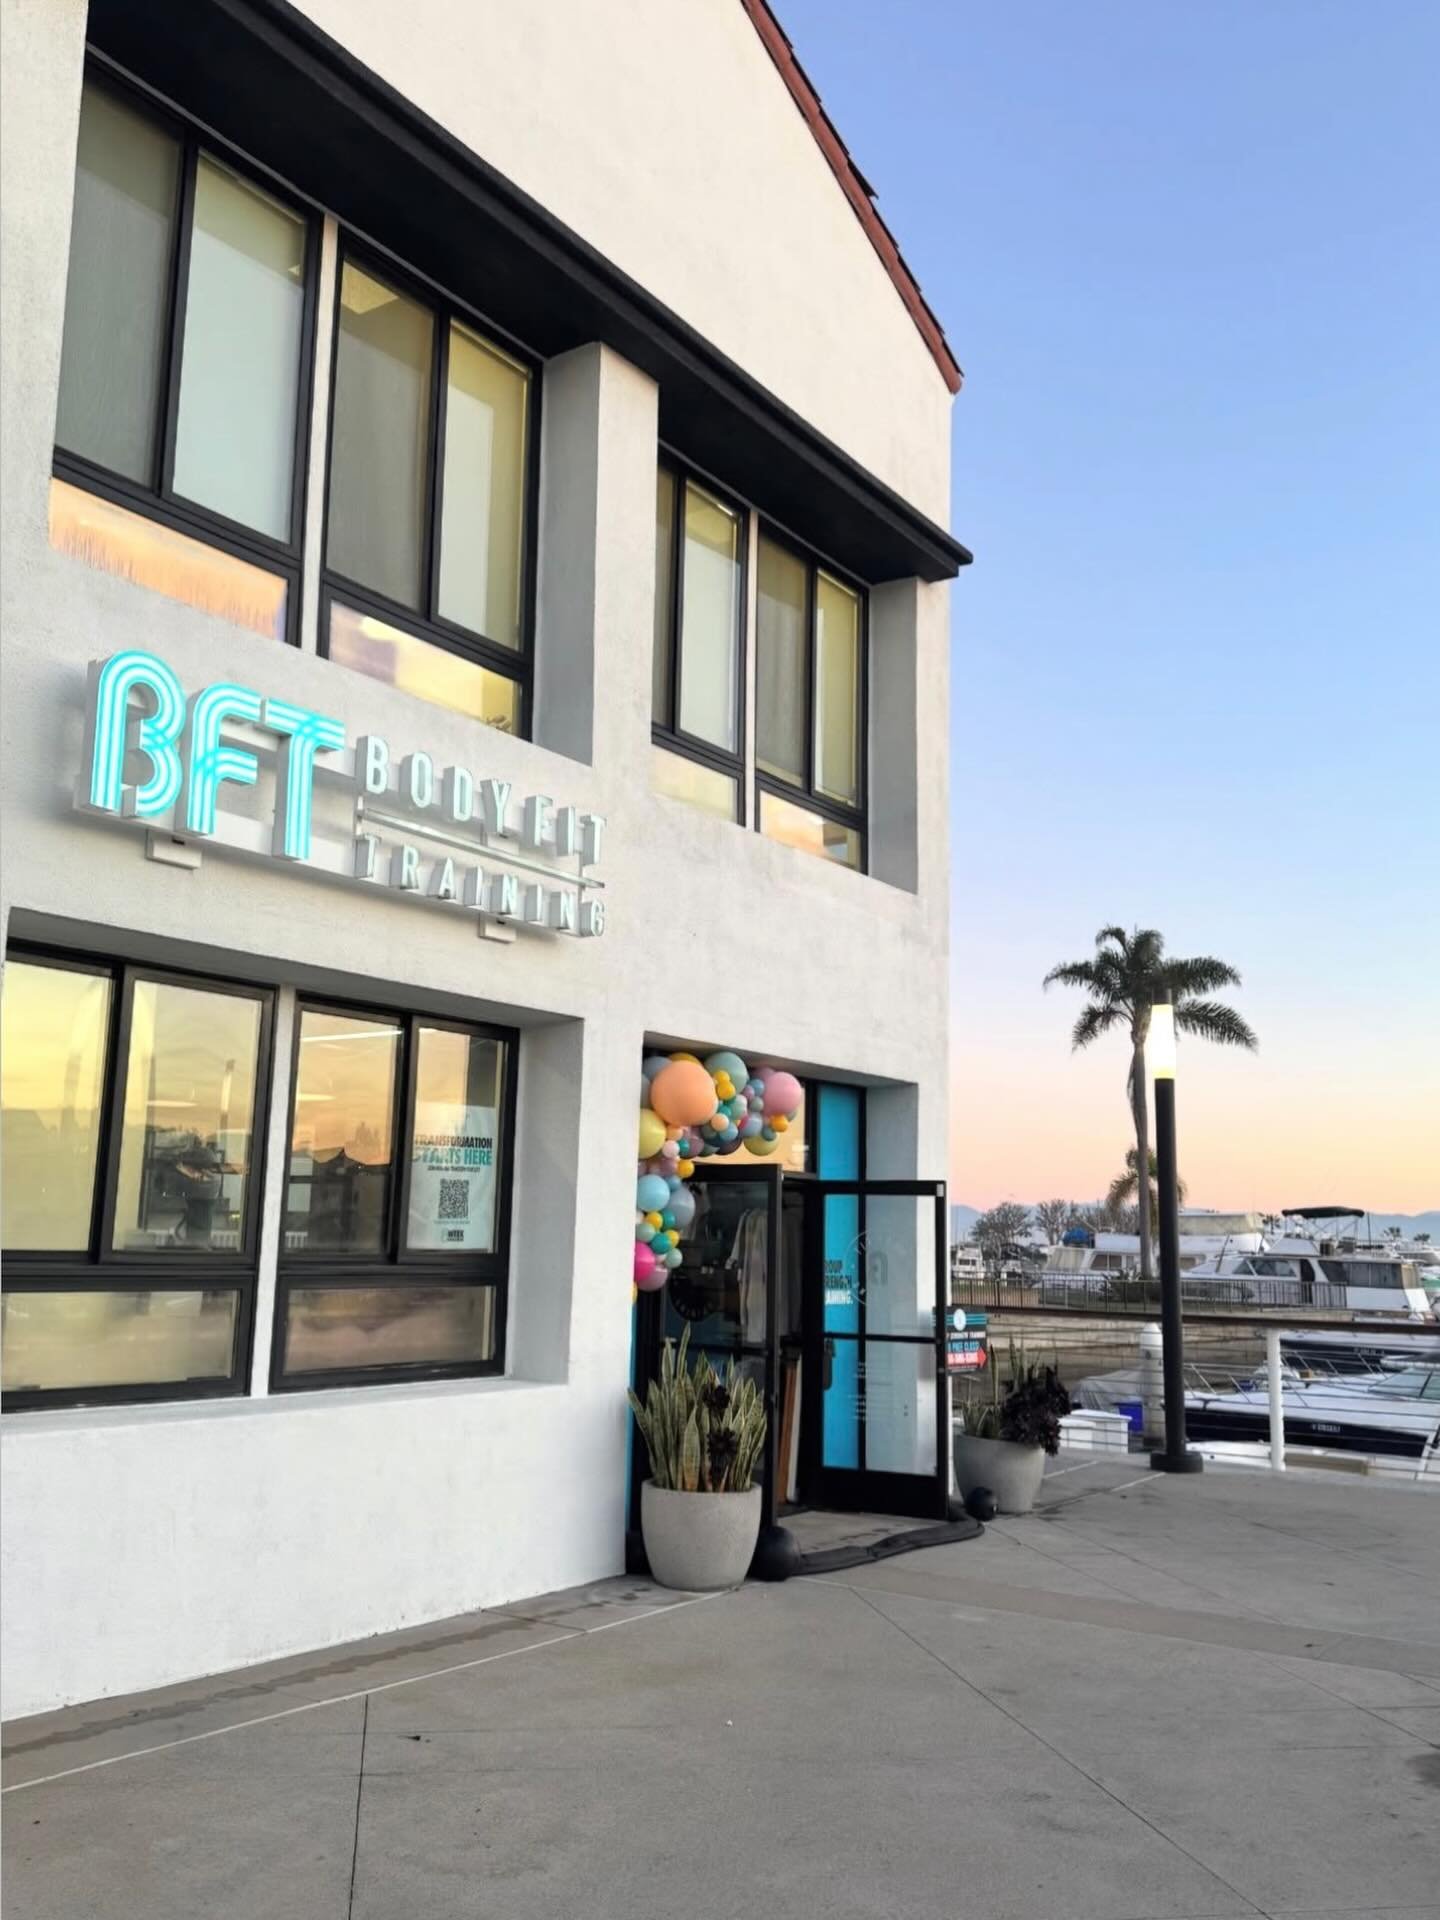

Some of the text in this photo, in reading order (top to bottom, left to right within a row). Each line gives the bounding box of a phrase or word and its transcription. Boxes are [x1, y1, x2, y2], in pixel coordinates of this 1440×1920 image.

[89, 648, 345, 860] BFT
[356, 735, 607, 866] BODY FIT
[353, 833, 606, 937] TRAINING
[415, 1135, 493, 1149] TRANSFORMATION
[463, 1148, 492, 1166] HERE
